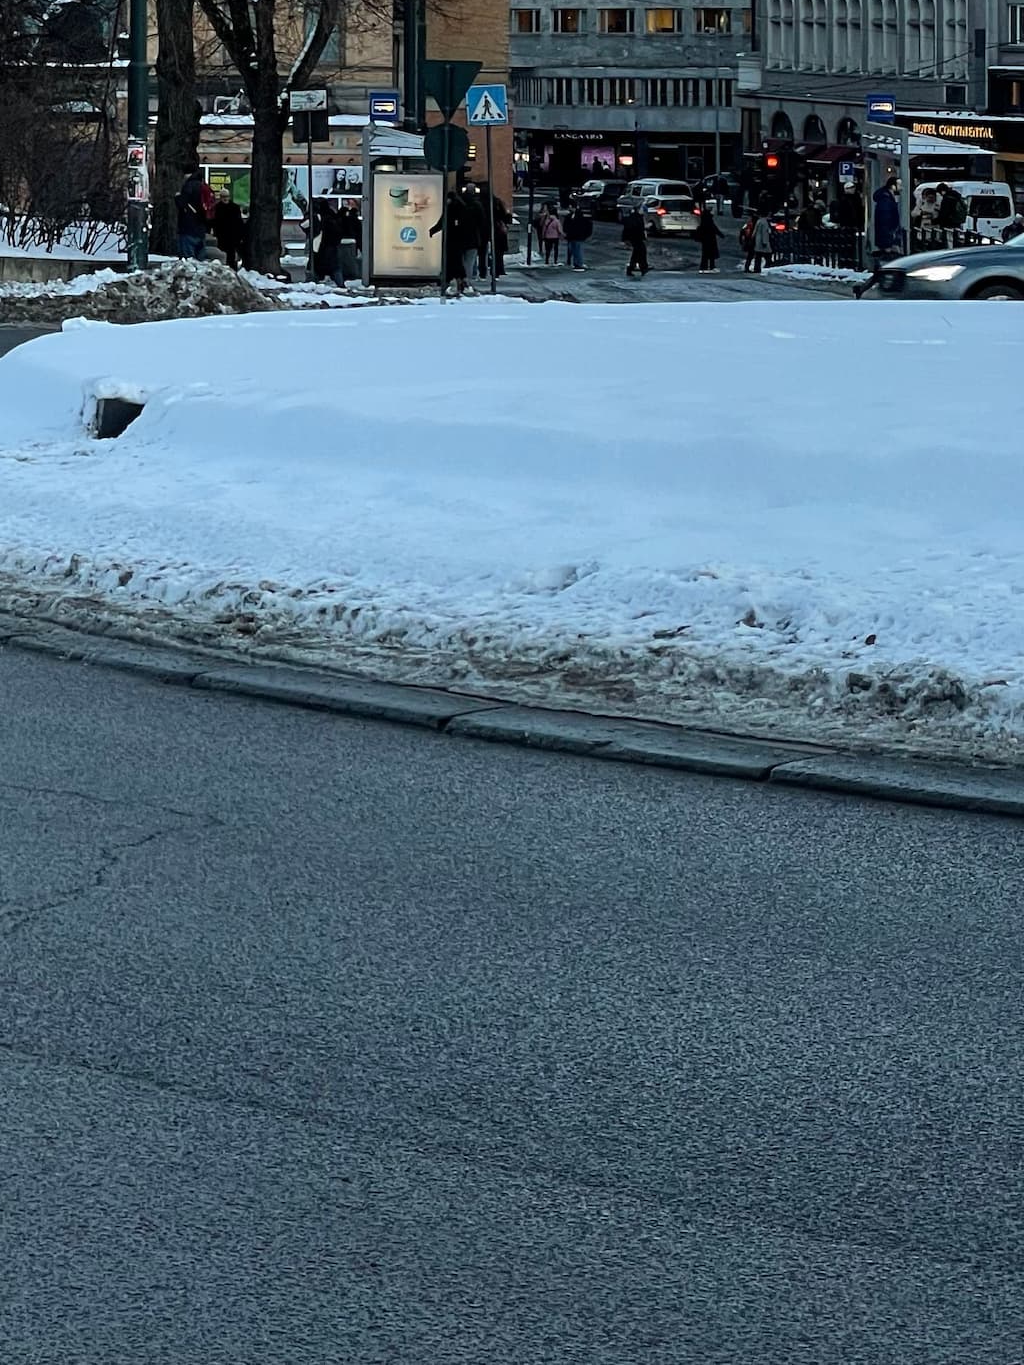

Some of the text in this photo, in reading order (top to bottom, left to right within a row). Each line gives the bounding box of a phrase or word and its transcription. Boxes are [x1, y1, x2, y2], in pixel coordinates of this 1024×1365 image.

[913, 123, 993, 139] HOTEL CONTINENTAL
[842, 163, 850, 174] P
